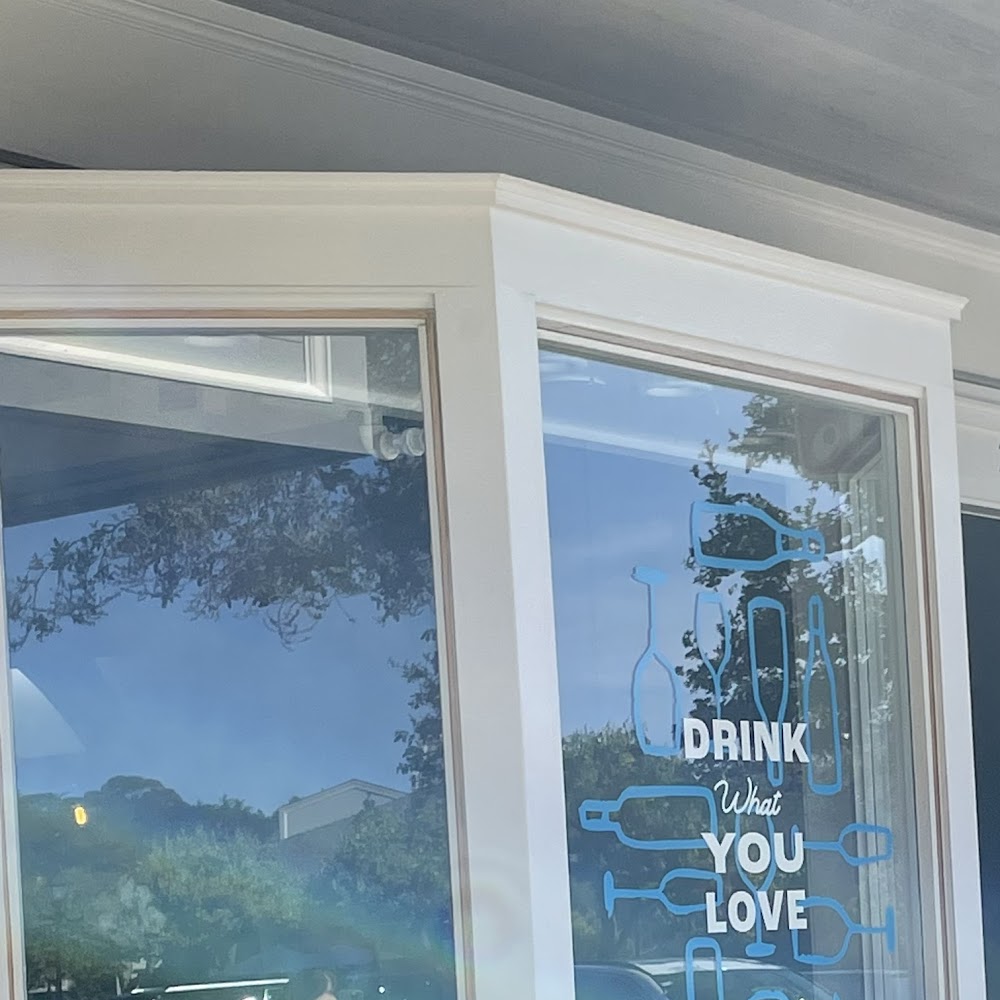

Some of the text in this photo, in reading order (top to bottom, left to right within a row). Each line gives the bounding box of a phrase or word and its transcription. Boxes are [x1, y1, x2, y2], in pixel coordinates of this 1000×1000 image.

[683, 717, 810, 763] DRINK
[714, 777, 784, 816] What
[700, 831, 805, 873] YOU
[705, 889, 808, 933] LOVE
